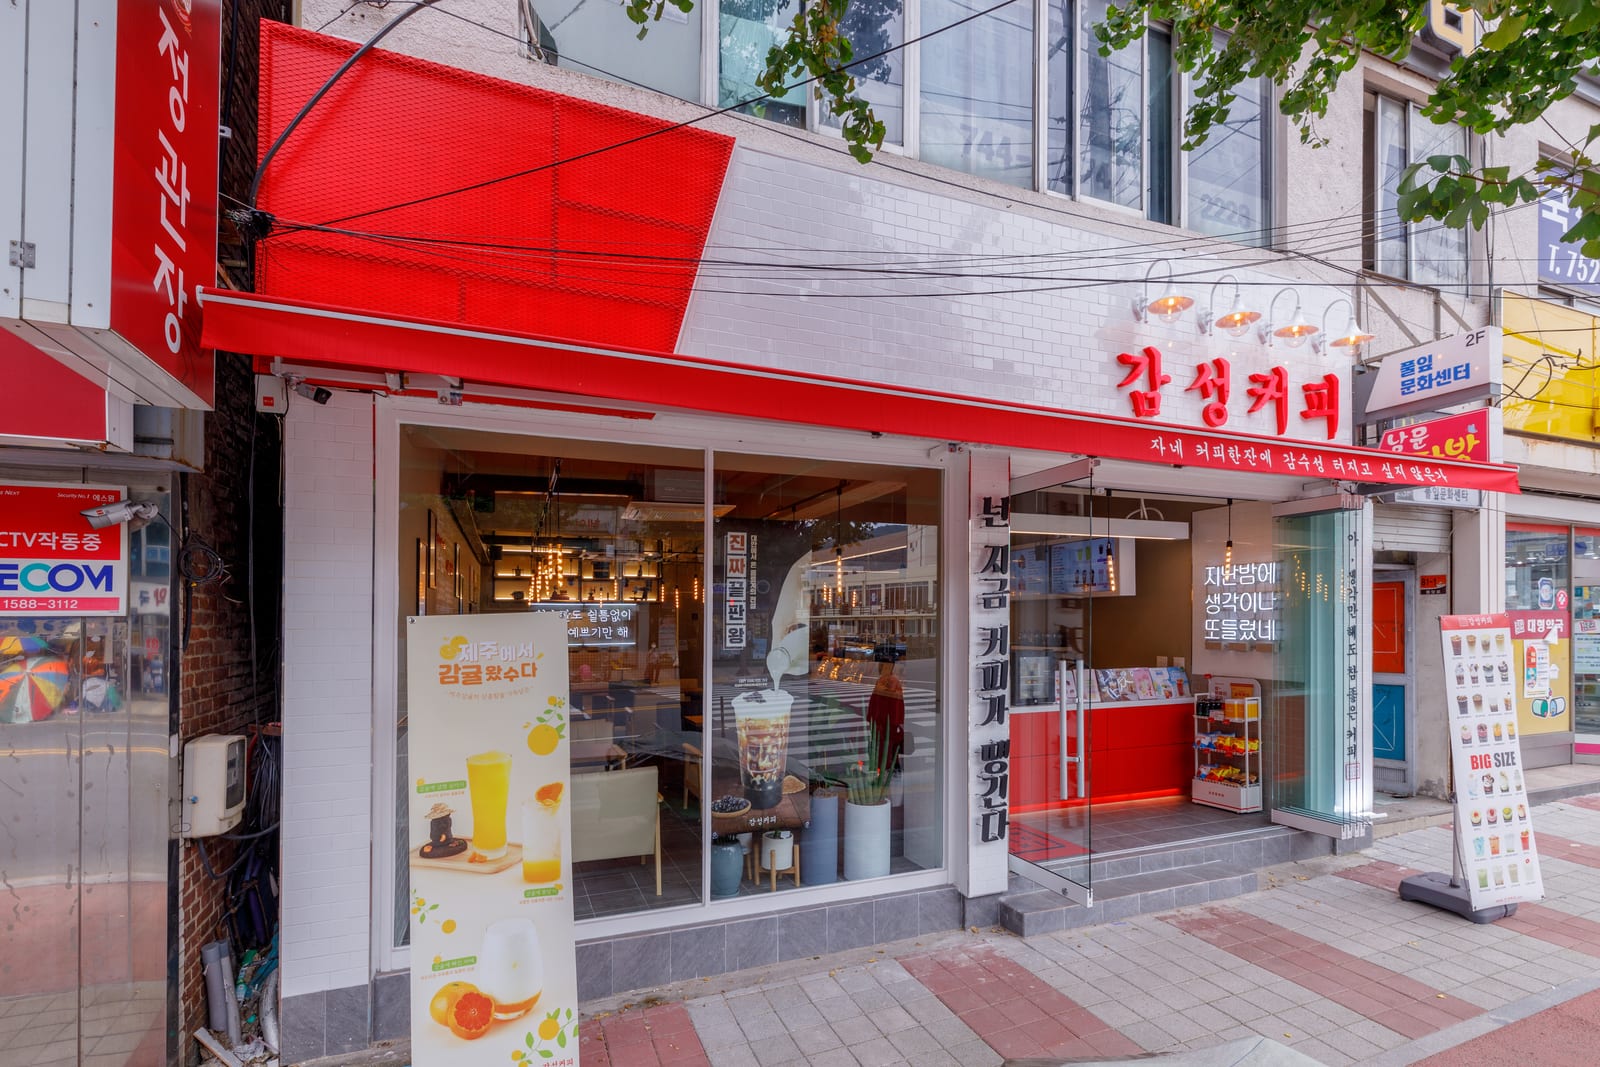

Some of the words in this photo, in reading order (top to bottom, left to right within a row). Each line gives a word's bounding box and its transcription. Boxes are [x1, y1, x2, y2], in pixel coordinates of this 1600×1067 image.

[1465, 330, 1485, 347] 2F
[1400, 354, 1433, 378] 풀잎
[1400, 362, 1470, 396] 문화센터
[1116, 346, 1340, 439] 감성커피
[1151, 437, 1184, 459] 자네
[1196, 443, 1272, 469] 커피한잔에
[1283, 453, 1325, 474] 감수성
[1333, 458, 1373, 477] 터지고
[1410, 466, 1448, 483] 않은가
[92, 494, 115, 502] 에스원
[983, 496, 1009, 528] 넌
[0, 562, 113, 592] ECOM
[980, 545, 1009, 609] 지금
[1204, 562, 1276, 587] 지난밤에
[3, 599, 78, 609] 1588-3112
[1204, 592, 1277, 615] 생각이나
[587, 608, 631, 623] 쉴틈없이
[567, 626, 613, 639] 예쁘기만
[617, 626, 629, 638] 해
[1204, 619, 1276, 641] 또들렸네
[458, 640, 534, 662] 제주에서
[438, 663, 482, 685] 감귤
[486, 662, 538, 682] 왔수다
[979, 625, 1009, 727] 커피가
[1470, 753, 1492, 770] BIG
[1494, 751, 1516, 768] SIZE
